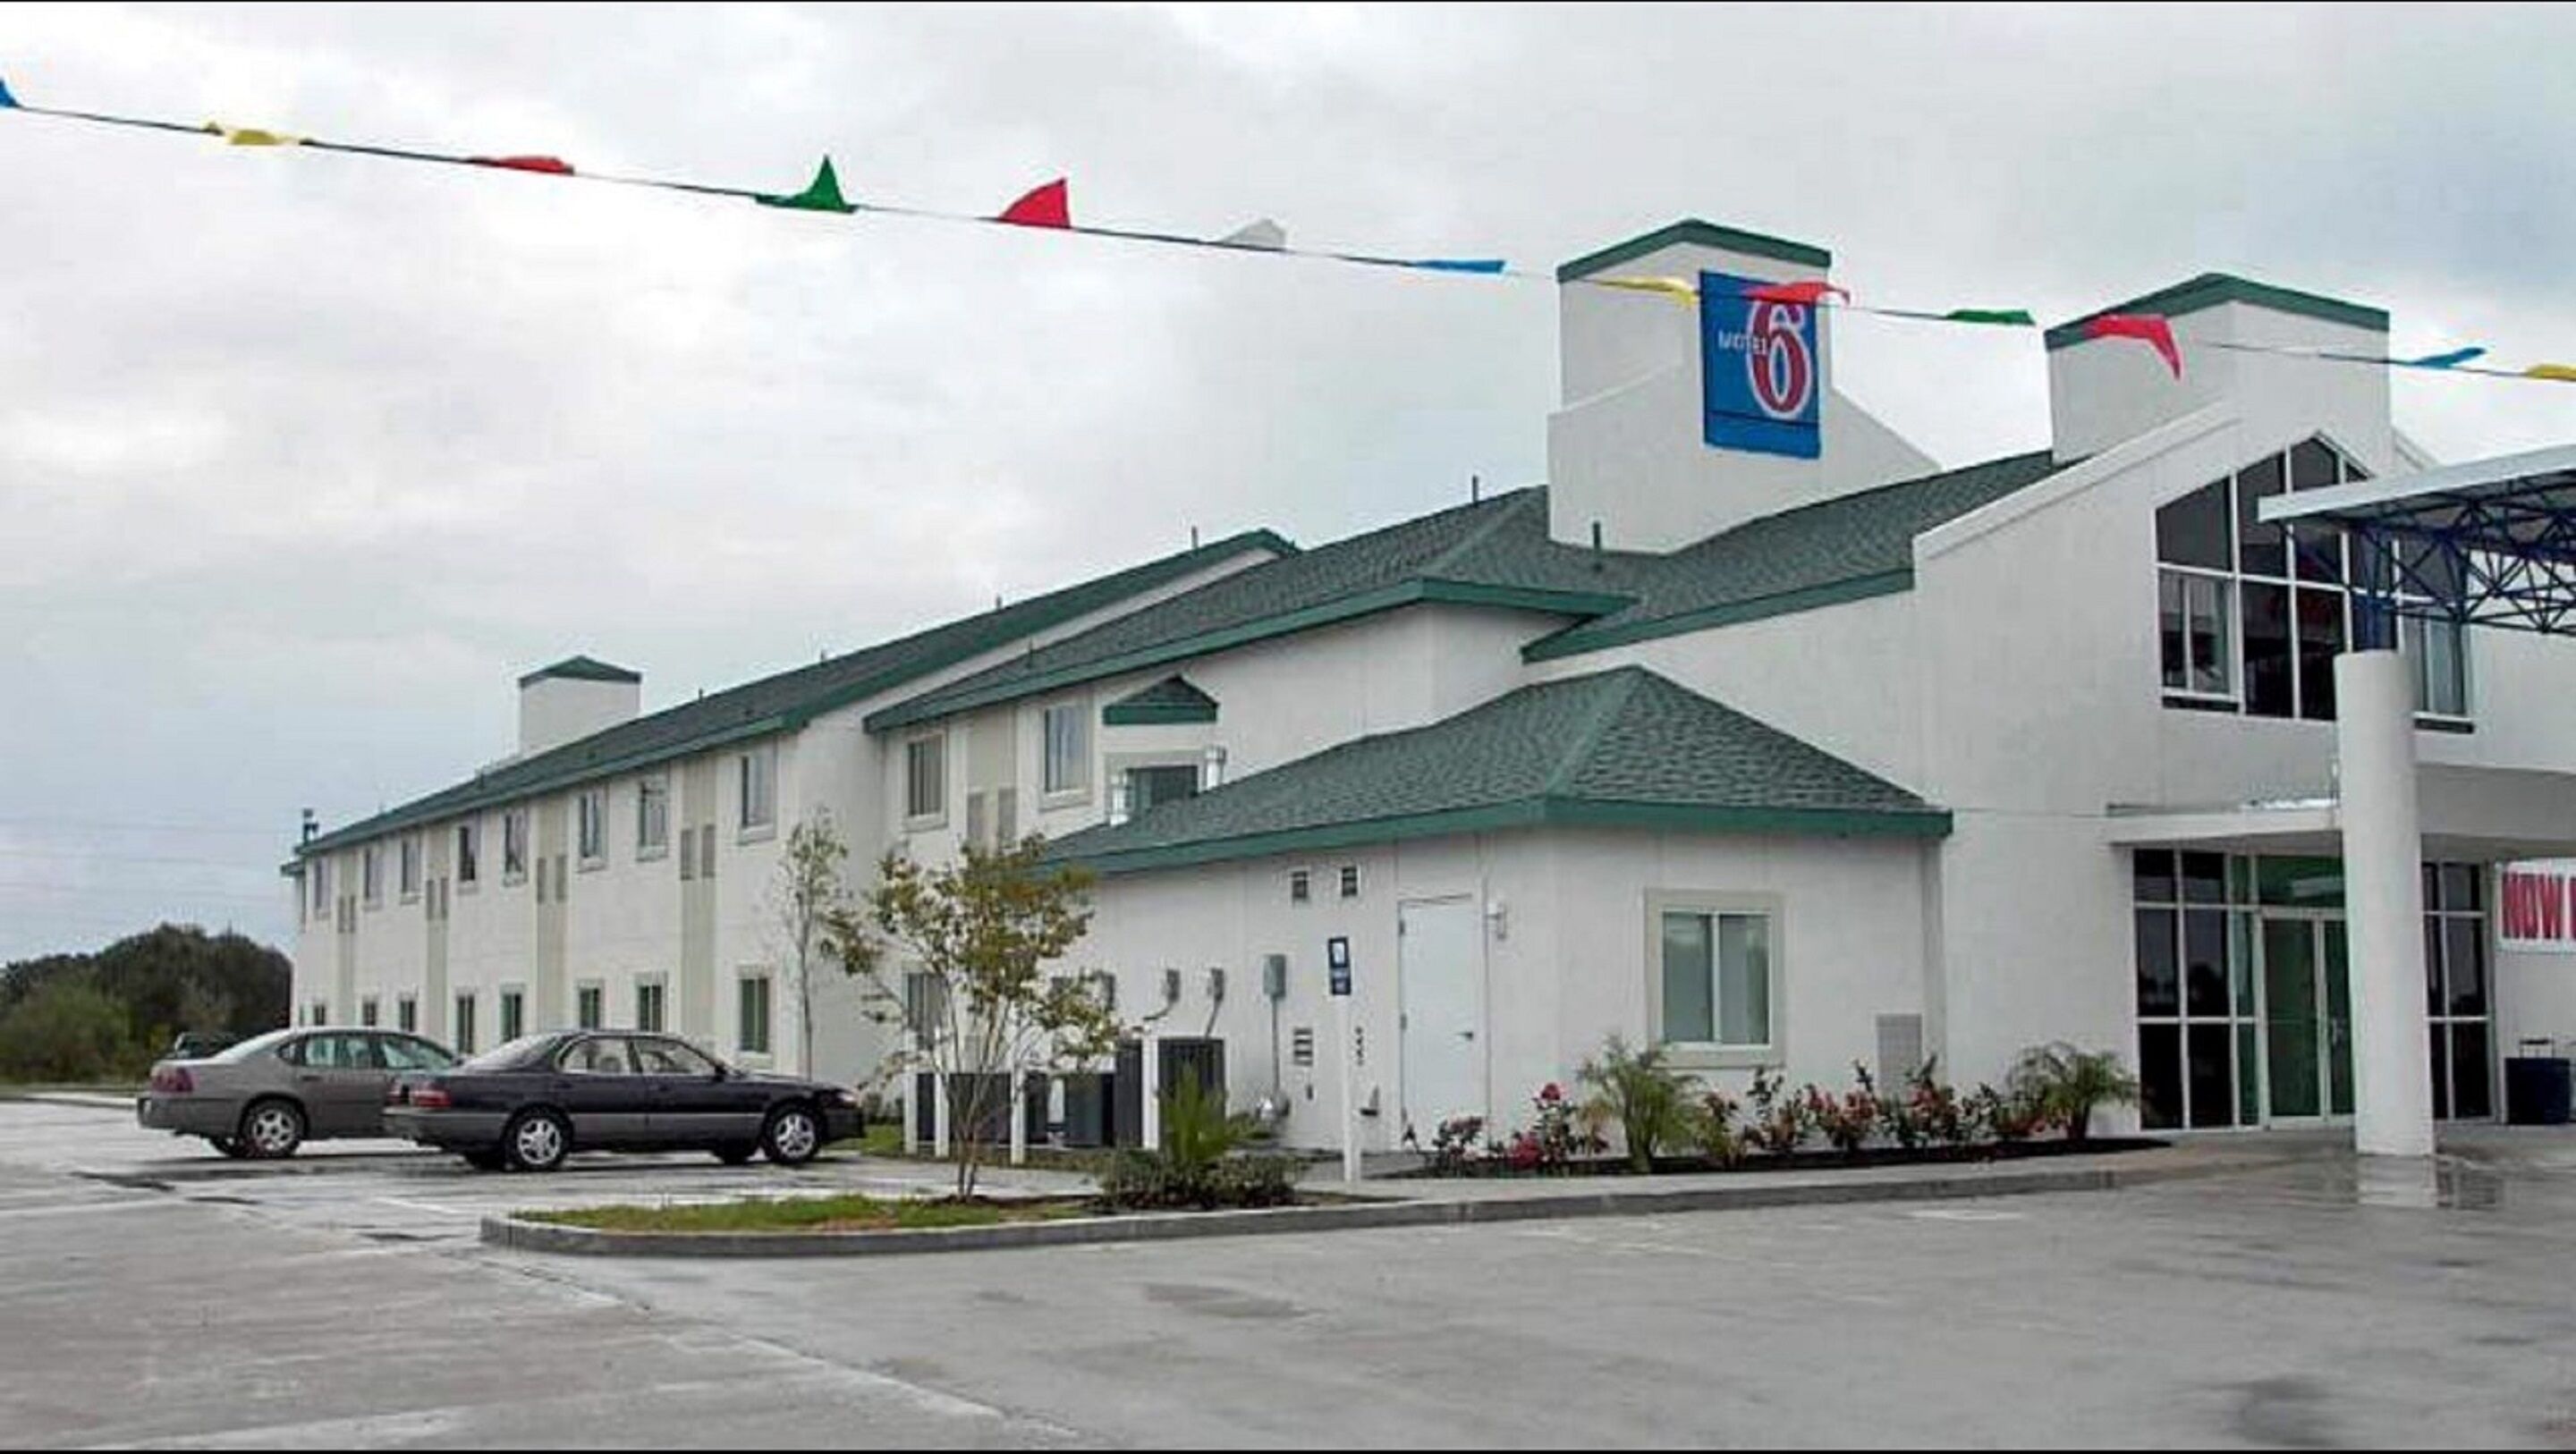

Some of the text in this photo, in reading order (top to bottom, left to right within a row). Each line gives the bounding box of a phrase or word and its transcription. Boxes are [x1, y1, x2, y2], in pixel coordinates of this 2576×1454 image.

[1718, 300, 1812, 420] MOTEL 6
[2503, 873, 2563, 939] NOW
